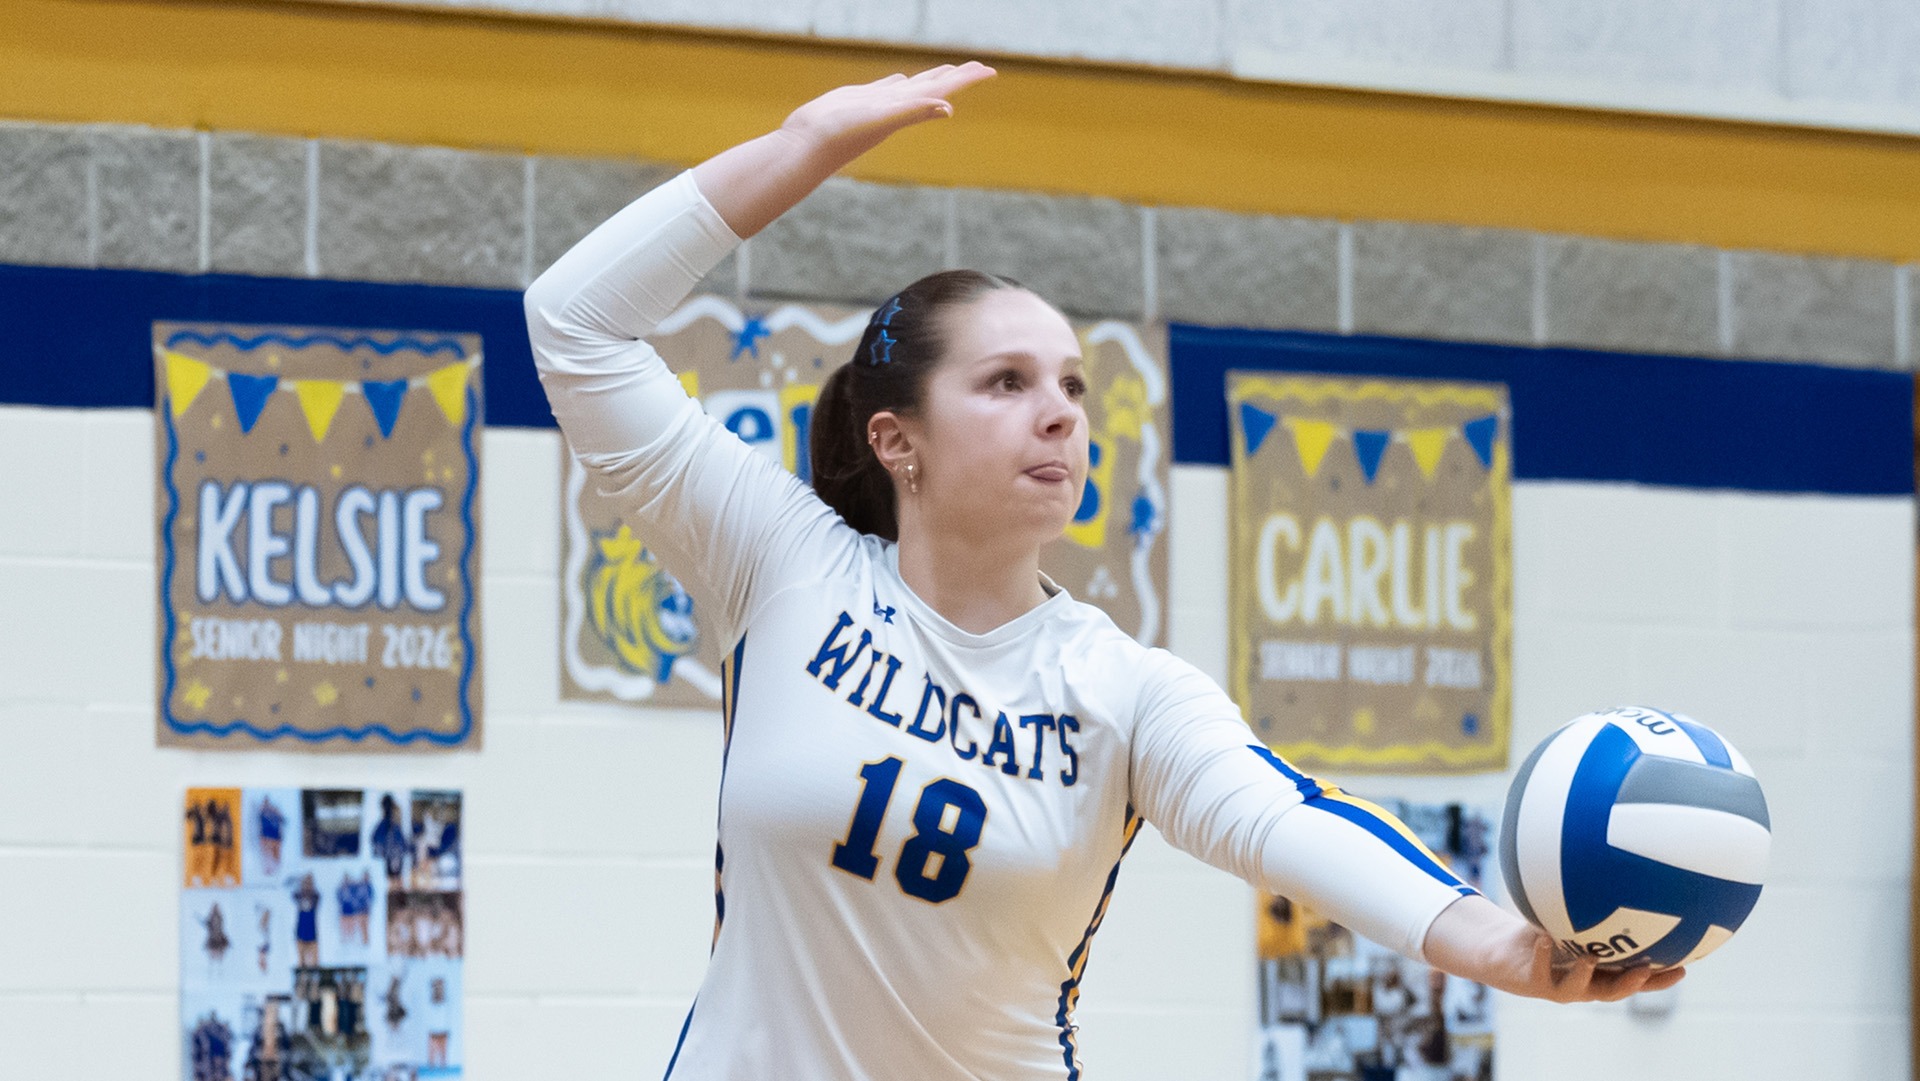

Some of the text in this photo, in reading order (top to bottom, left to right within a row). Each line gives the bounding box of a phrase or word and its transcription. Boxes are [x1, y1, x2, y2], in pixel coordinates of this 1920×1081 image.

[197, 480, 446, 611] KELSIE
[1257, 514, 1478, 631] CARLIE
[190, 617, 452, 669] SENIOR NIGHT 2026
[805, 610, 1081, 787] WILDCATS
[829, 755, 988, 905] 18
